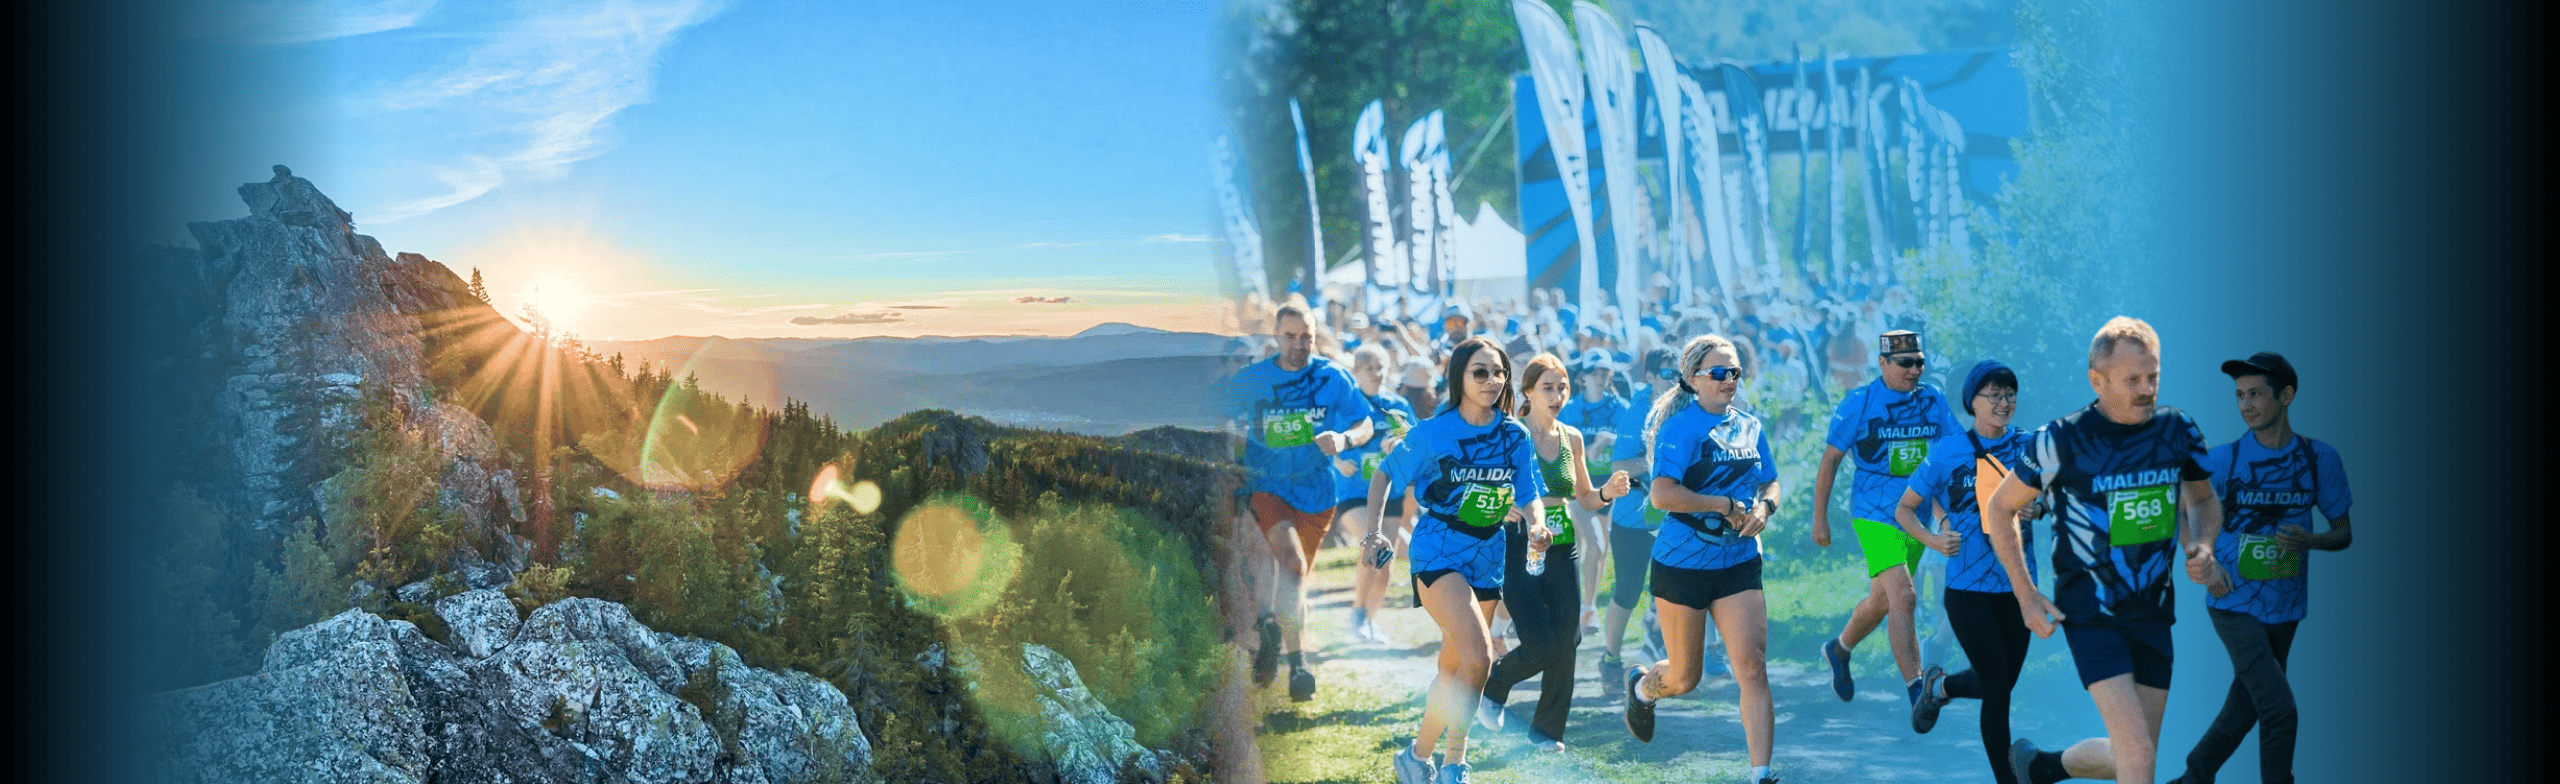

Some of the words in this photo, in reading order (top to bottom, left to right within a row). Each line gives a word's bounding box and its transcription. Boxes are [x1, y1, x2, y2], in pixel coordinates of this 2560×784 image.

[1273, 419, 1302, 433] 636
[1878, 425, 1937, 439] MALIDAK
[1900, 447, 1923, 460] 571
[2092, 466, 2180, 494] MALIDAK
[2123, 498, 2162, 520] 568
